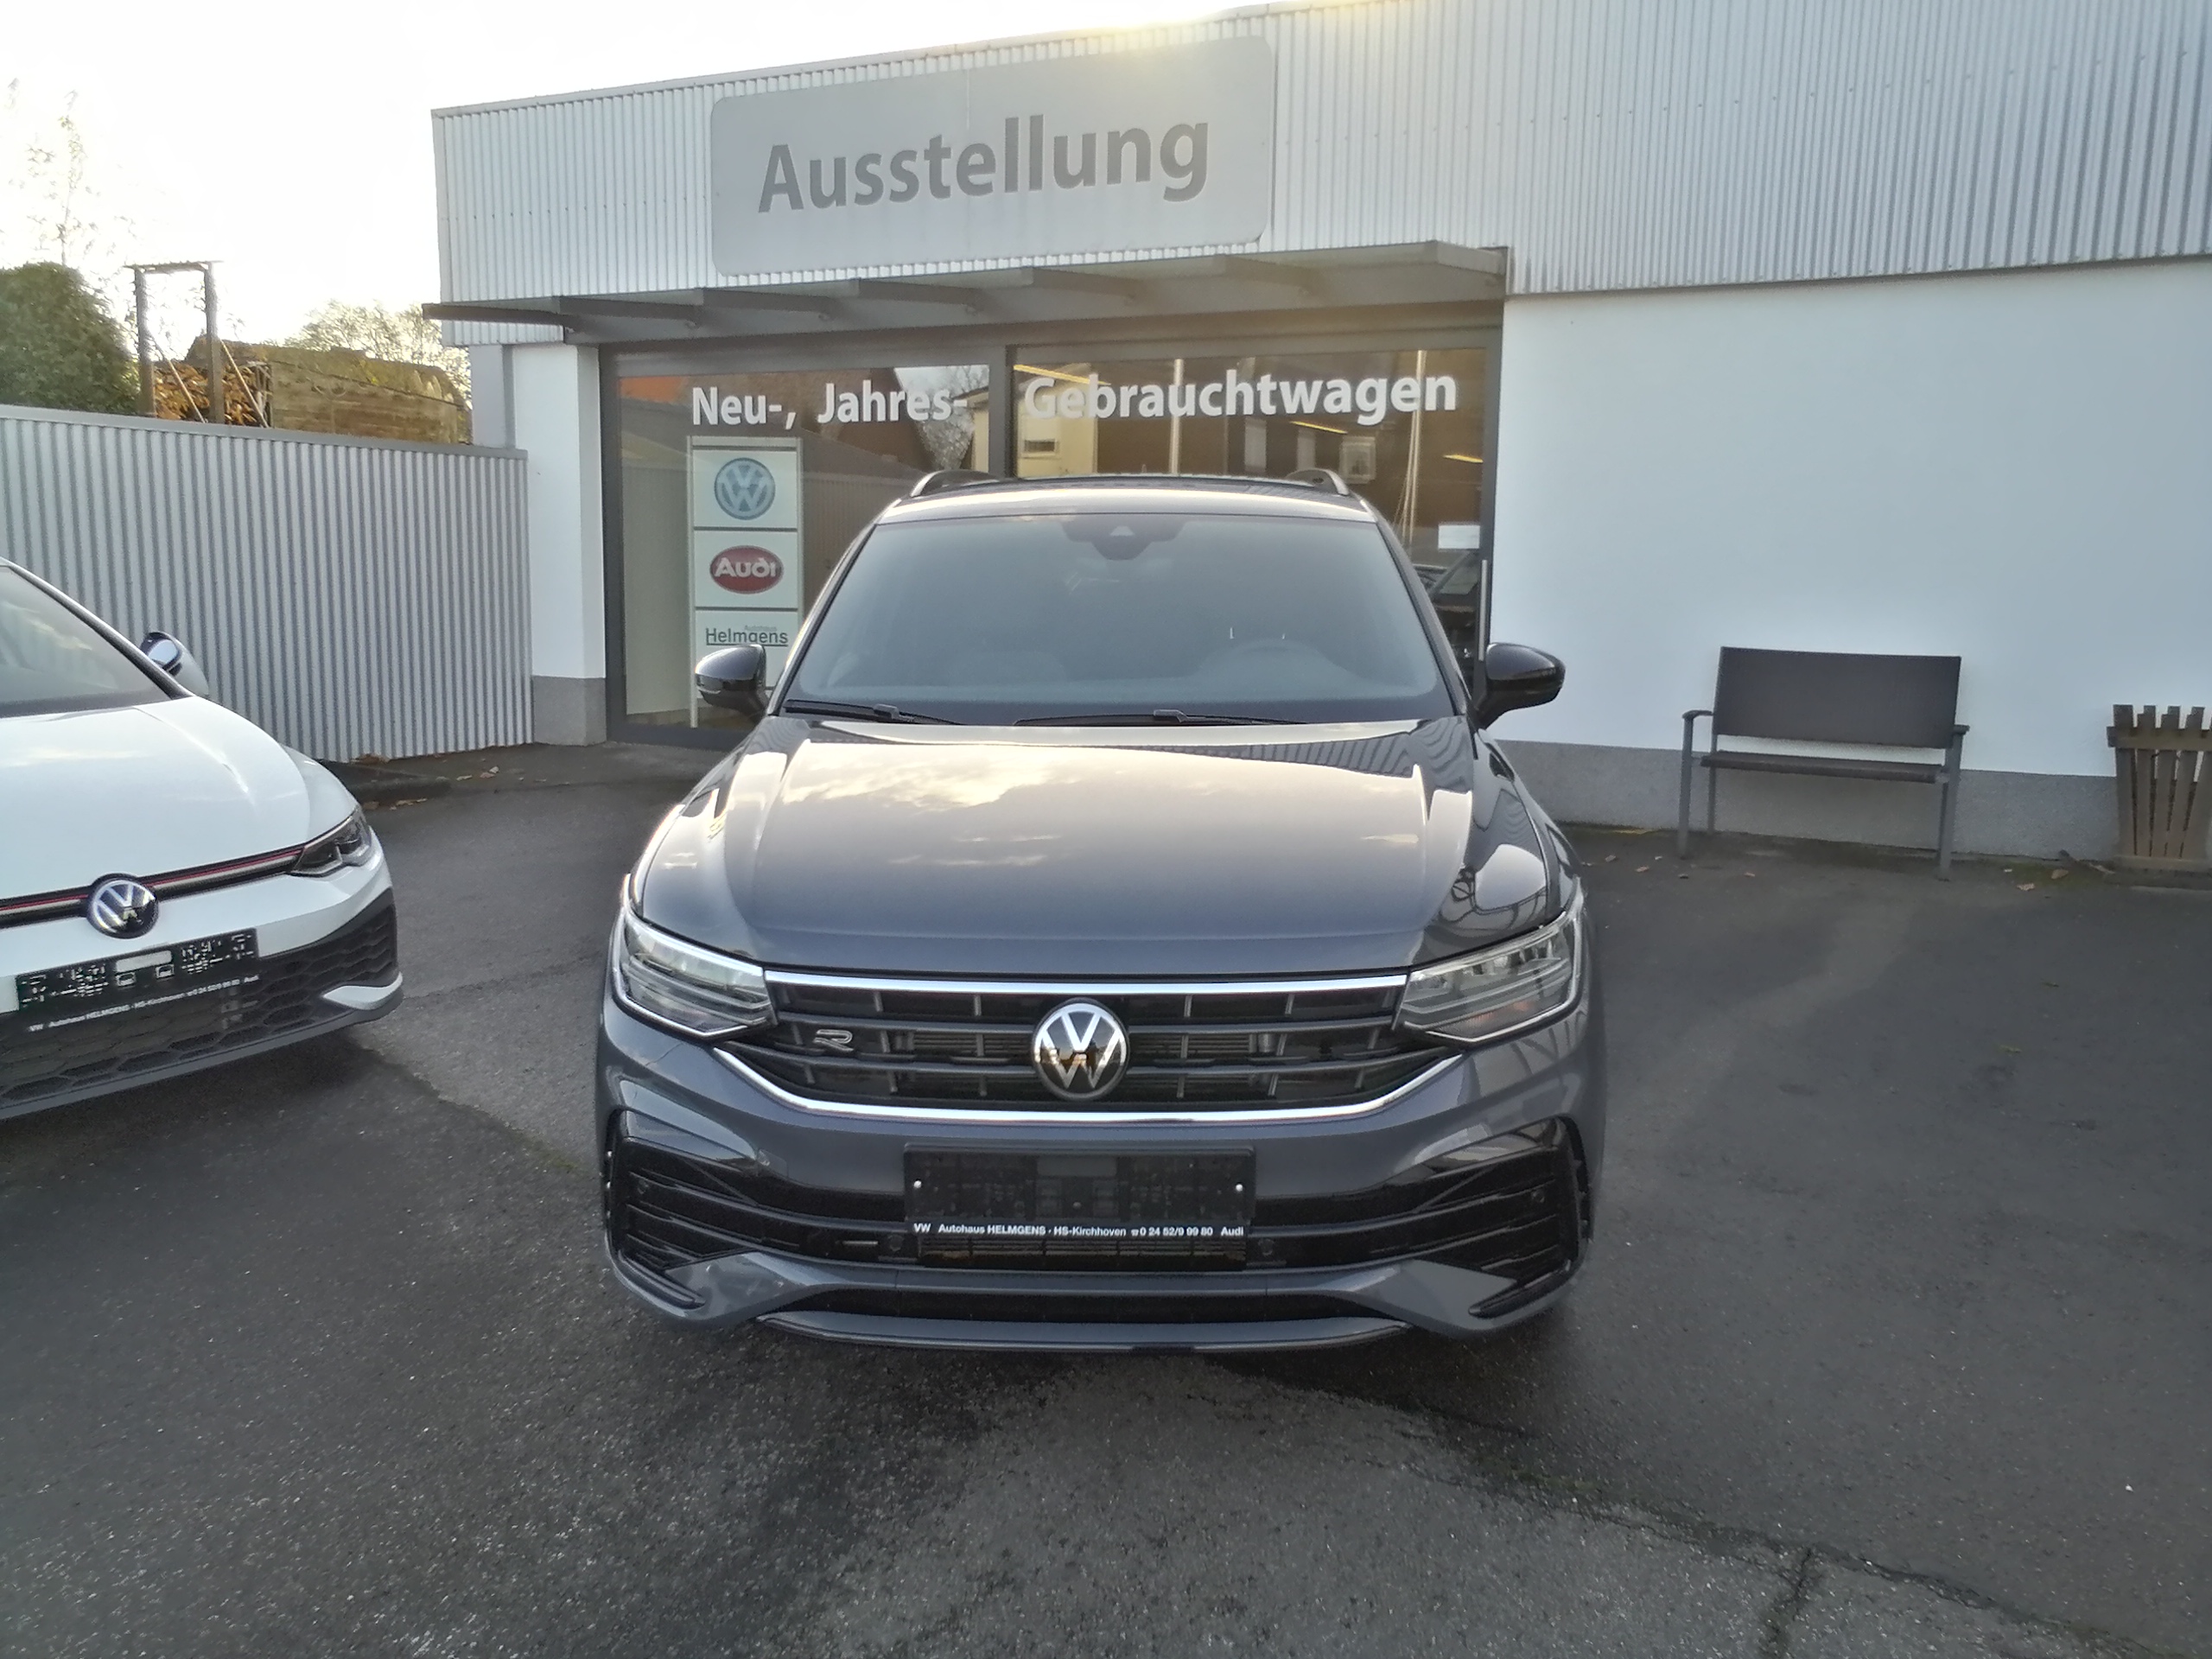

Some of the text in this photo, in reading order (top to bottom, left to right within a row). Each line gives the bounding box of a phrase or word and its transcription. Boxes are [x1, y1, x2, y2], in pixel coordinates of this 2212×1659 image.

[758, 113, 1209, 213] Ausstellung
[691, 368, 1458, 430] Neu-, Jahres- Gebrauchtwagen
[714, 556, 777, 578] Audi
[913, 1223, 931, 1233] VW
[938, 1224, 986, 1234] Autohaus
[987, 1224, 1046, 1236] HELMGENS
[1220, 1226, 1244, 1236] Audi
